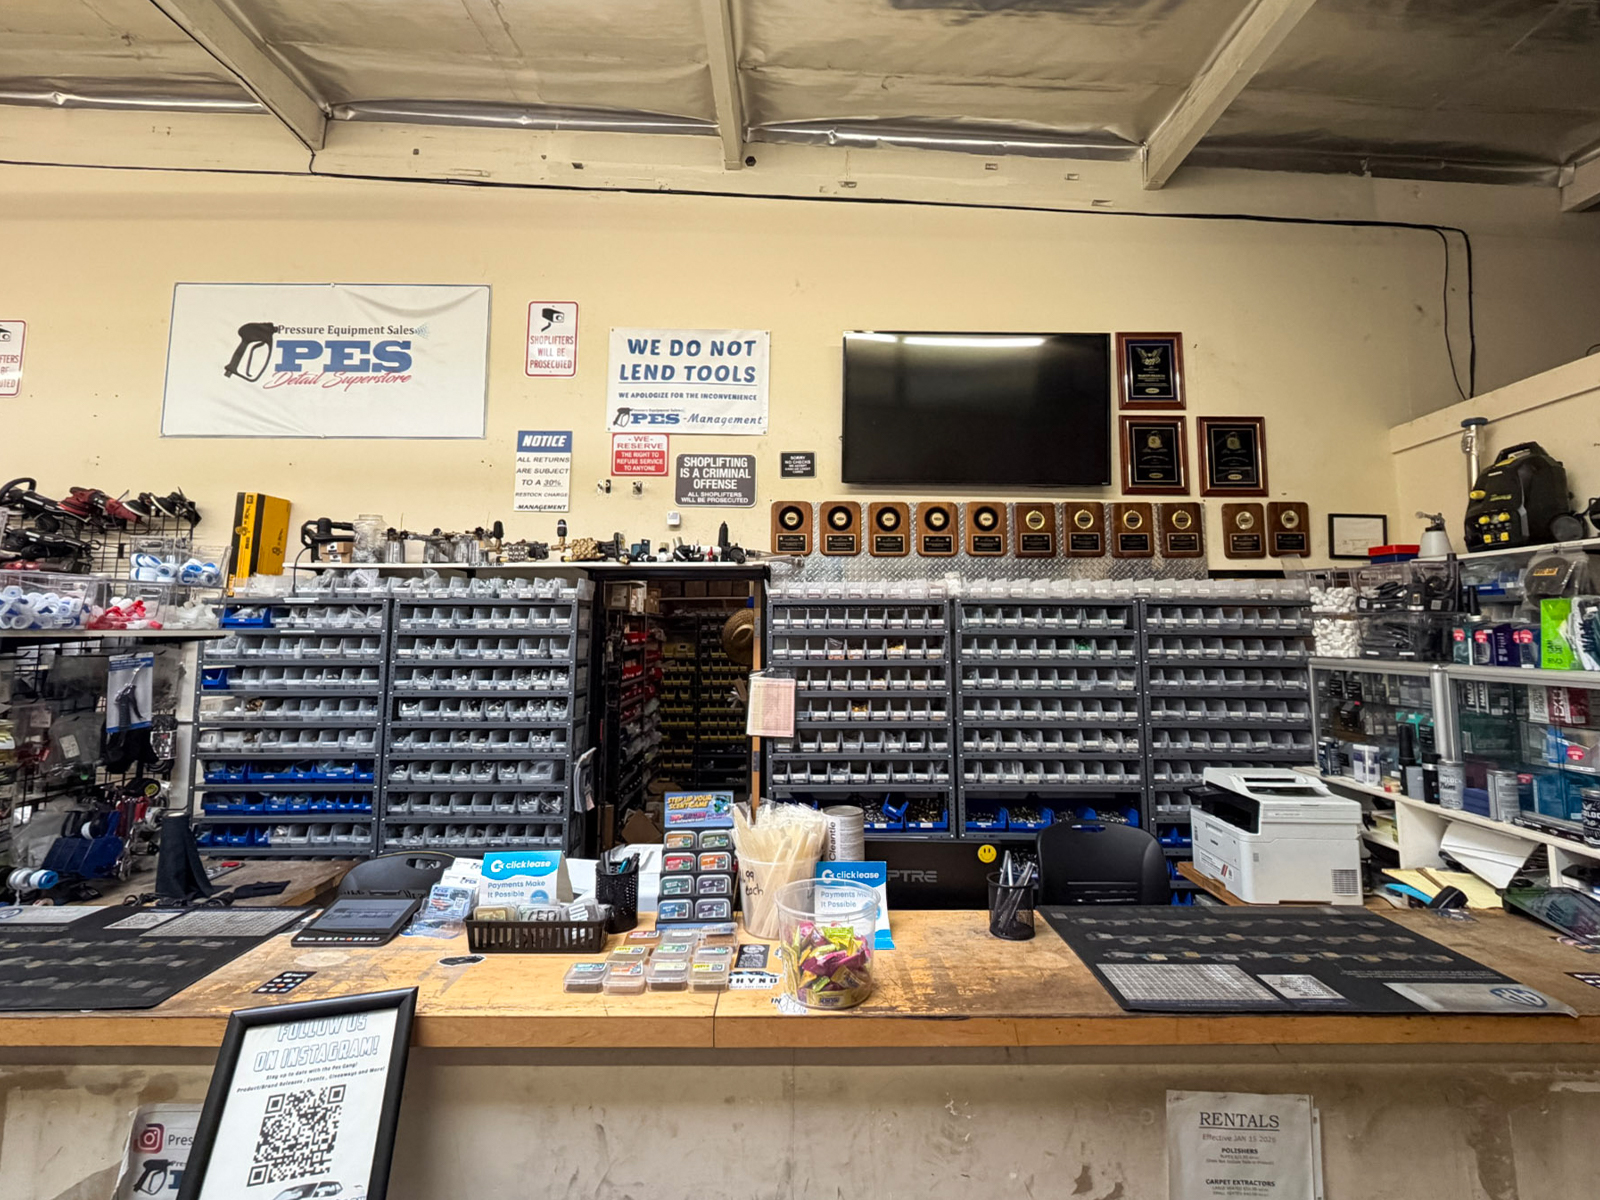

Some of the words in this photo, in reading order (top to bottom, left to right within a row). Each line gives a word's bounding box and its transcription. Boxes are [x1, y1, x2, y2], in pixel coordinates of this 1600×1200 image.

[277, 325, 325, 335] Pressure
[327, 325, 385, 337] Equipment
[387, 325, 415, 335] Sales
[530, 335, 574, 345] SHOPLIFTERS
[537, 348, 553, 357] WILL
[556, 347, 566, 357] BE
[627, 338, 661, 356] WE
[669, 339, 701, 357] DO
[710, 340, 757, 357] NOT
[274, 340, 413, 373] PES
[530, 360, 573, 369] PROSECUTED
[619, 364, 676, 381] LEND
[684, 365, 756, 383] TOOLS
[263, 370, 325, 389] Detail
[322, 370, 413, 392] Superstore
[700, 393, 757, 401] INCONVENIENCE
[630, 413, 680, 425] PES
[522, 434, 567, 447] NOTICE
[683, 456, 748, 468] SHOPLIFTING
[680, 468, 690, 478] IS
[692, 468, 700, 478] A
[702, 468, 752, 479] CRIMINAL
[543, 479, 562, 487] 30%
[693, 478, 738, 490] OFFENSE
[505, 860, 552, 869] clicklease
[836, 870, 880, 879] clicklease
[487, 881, 524, 889] Payments
[494, 890, 525, 898] Possible
[820, 891, 856, 899] Payments
[277, 1016, 344, 1042] FOLLOW
[346, 1014, 368, 1033] US
[253, 1050, 279, 1072] ON
[280, 1035, 381, 1069] INSTAGRAM!
[1199, 1111, 1280, 1128] RENTALS
[1202, 1133, 1232, 1142] Effective
[1232, 1179, 1276, 1187] EXTRACTORS
